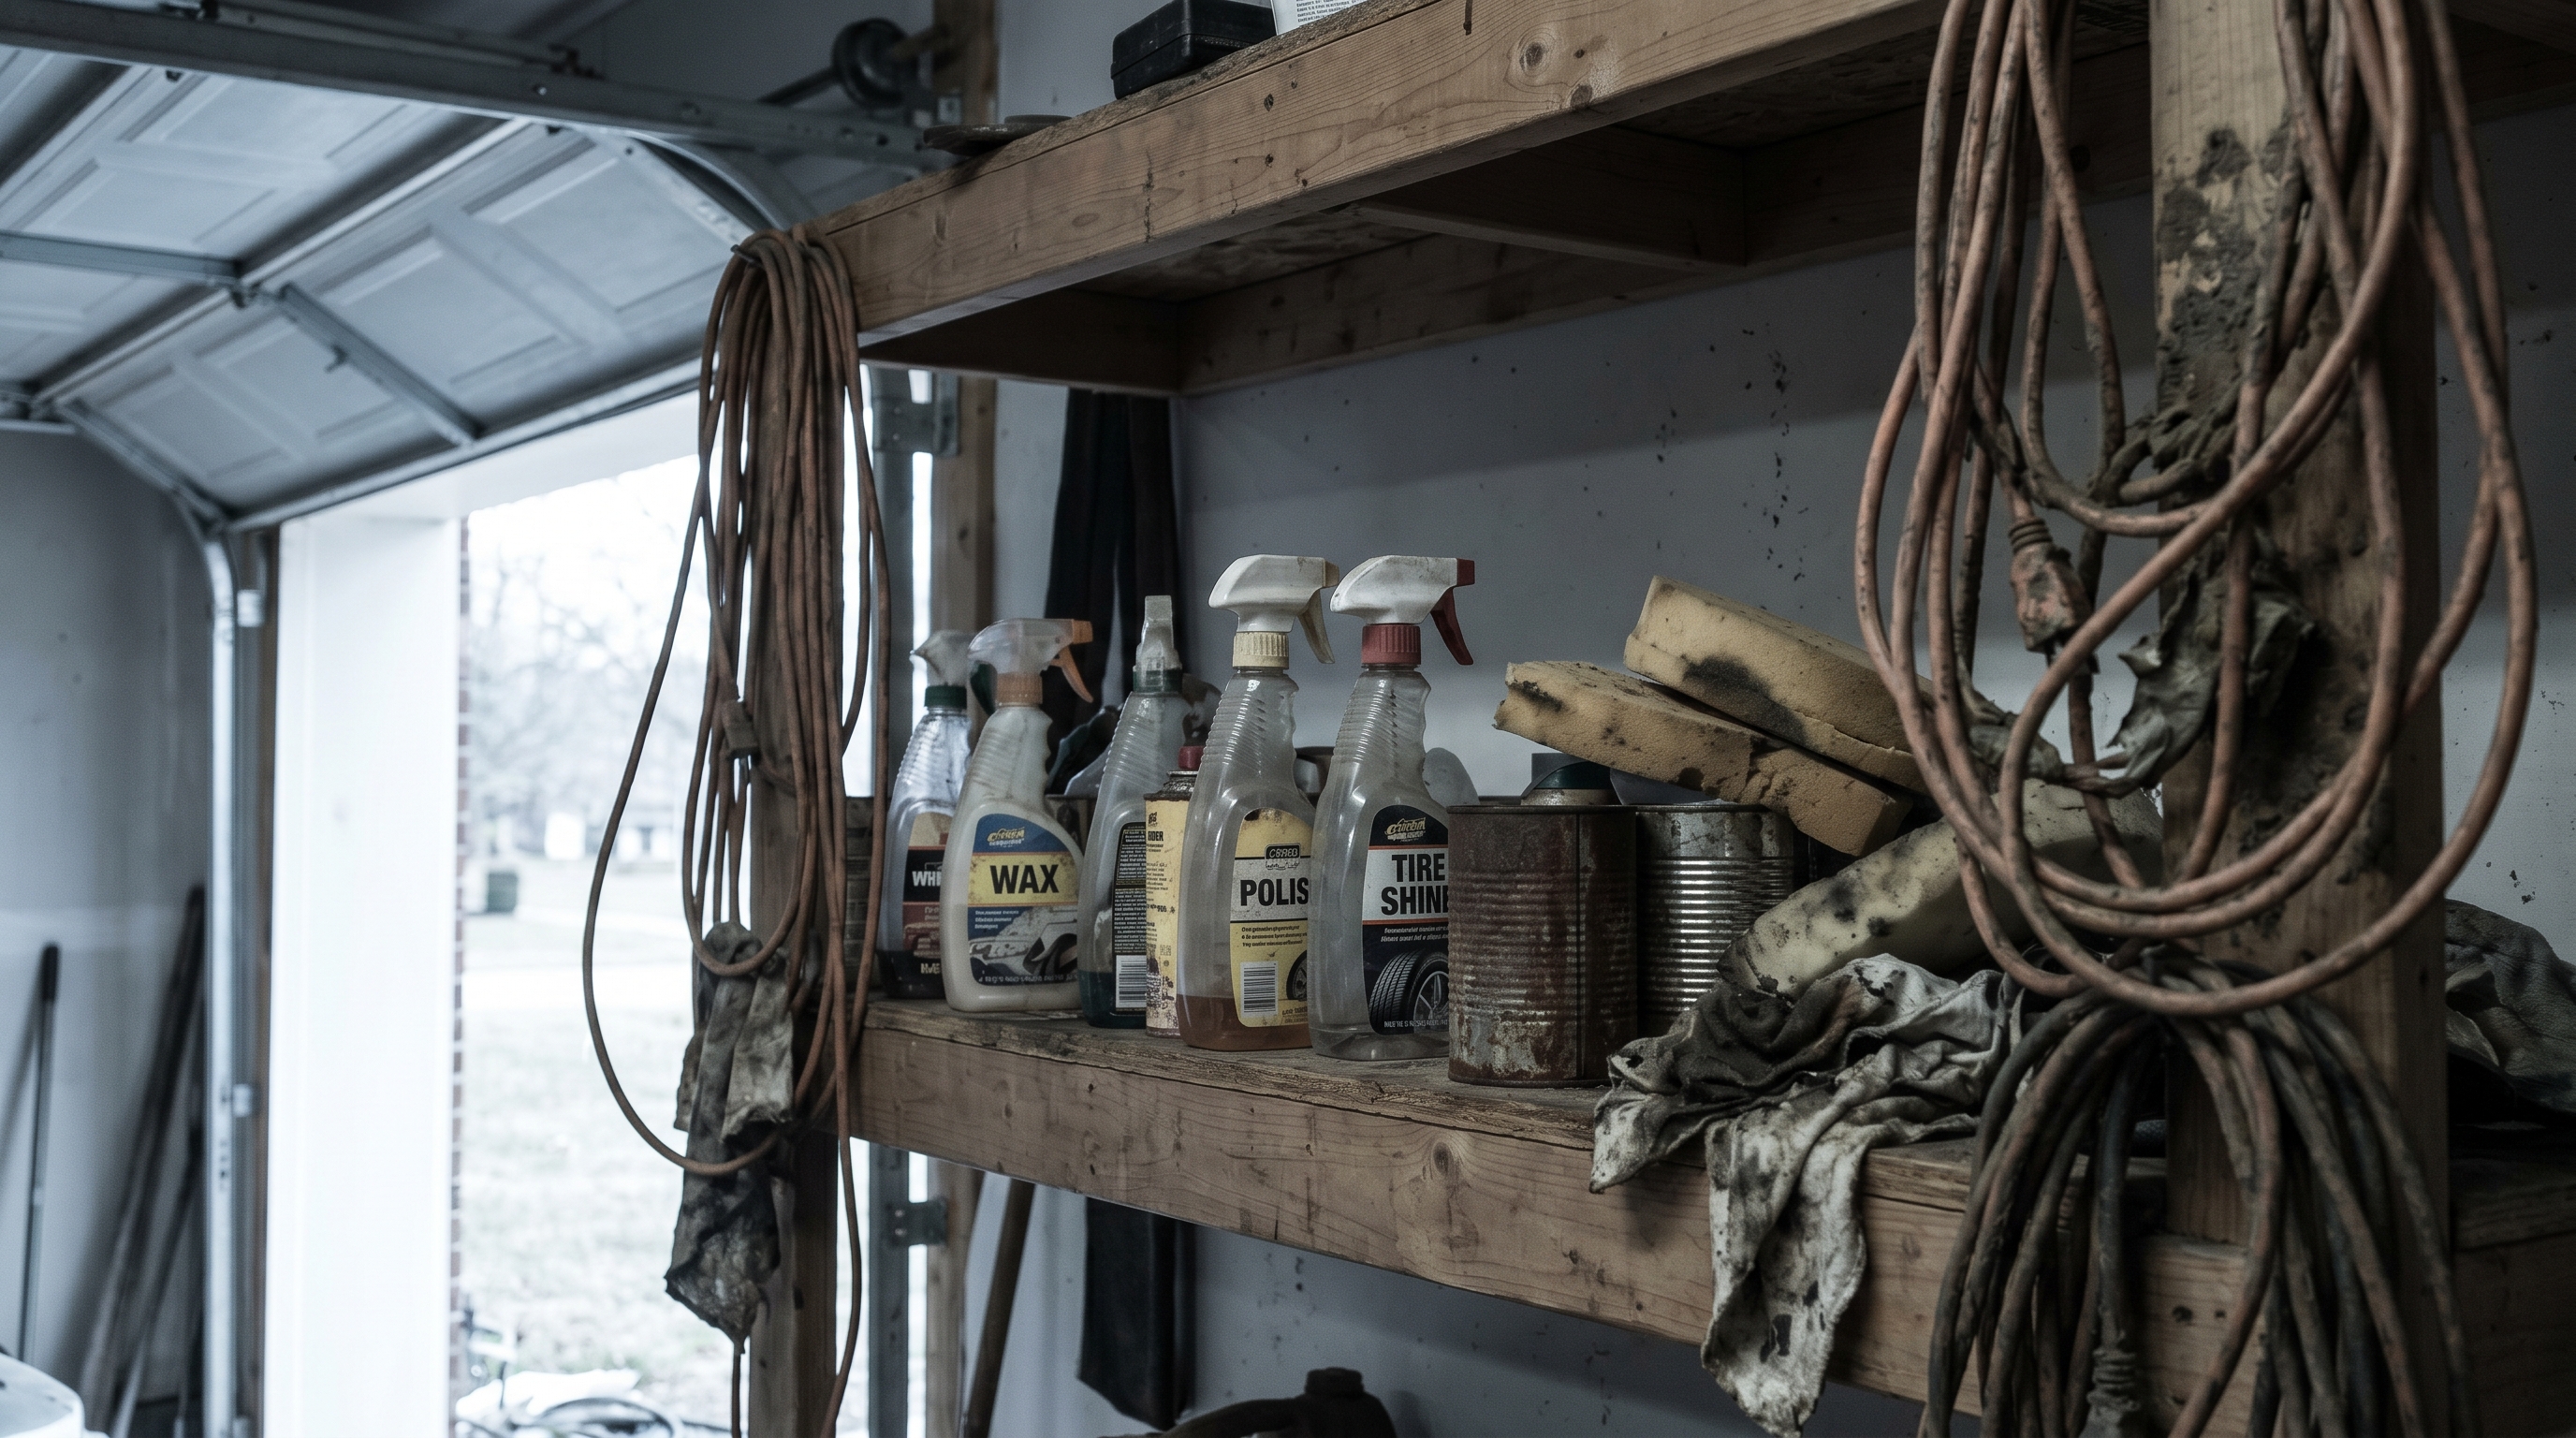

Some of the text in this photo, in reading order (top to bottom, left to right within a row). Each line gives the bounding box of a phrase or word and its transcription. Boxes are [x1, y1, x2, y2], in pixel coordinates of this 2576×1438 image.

[989, 863, 1060, 895] WAX
[1391, 852, 1446, 883] TIRE
[1240, 876, 1310, 907] POLIS
